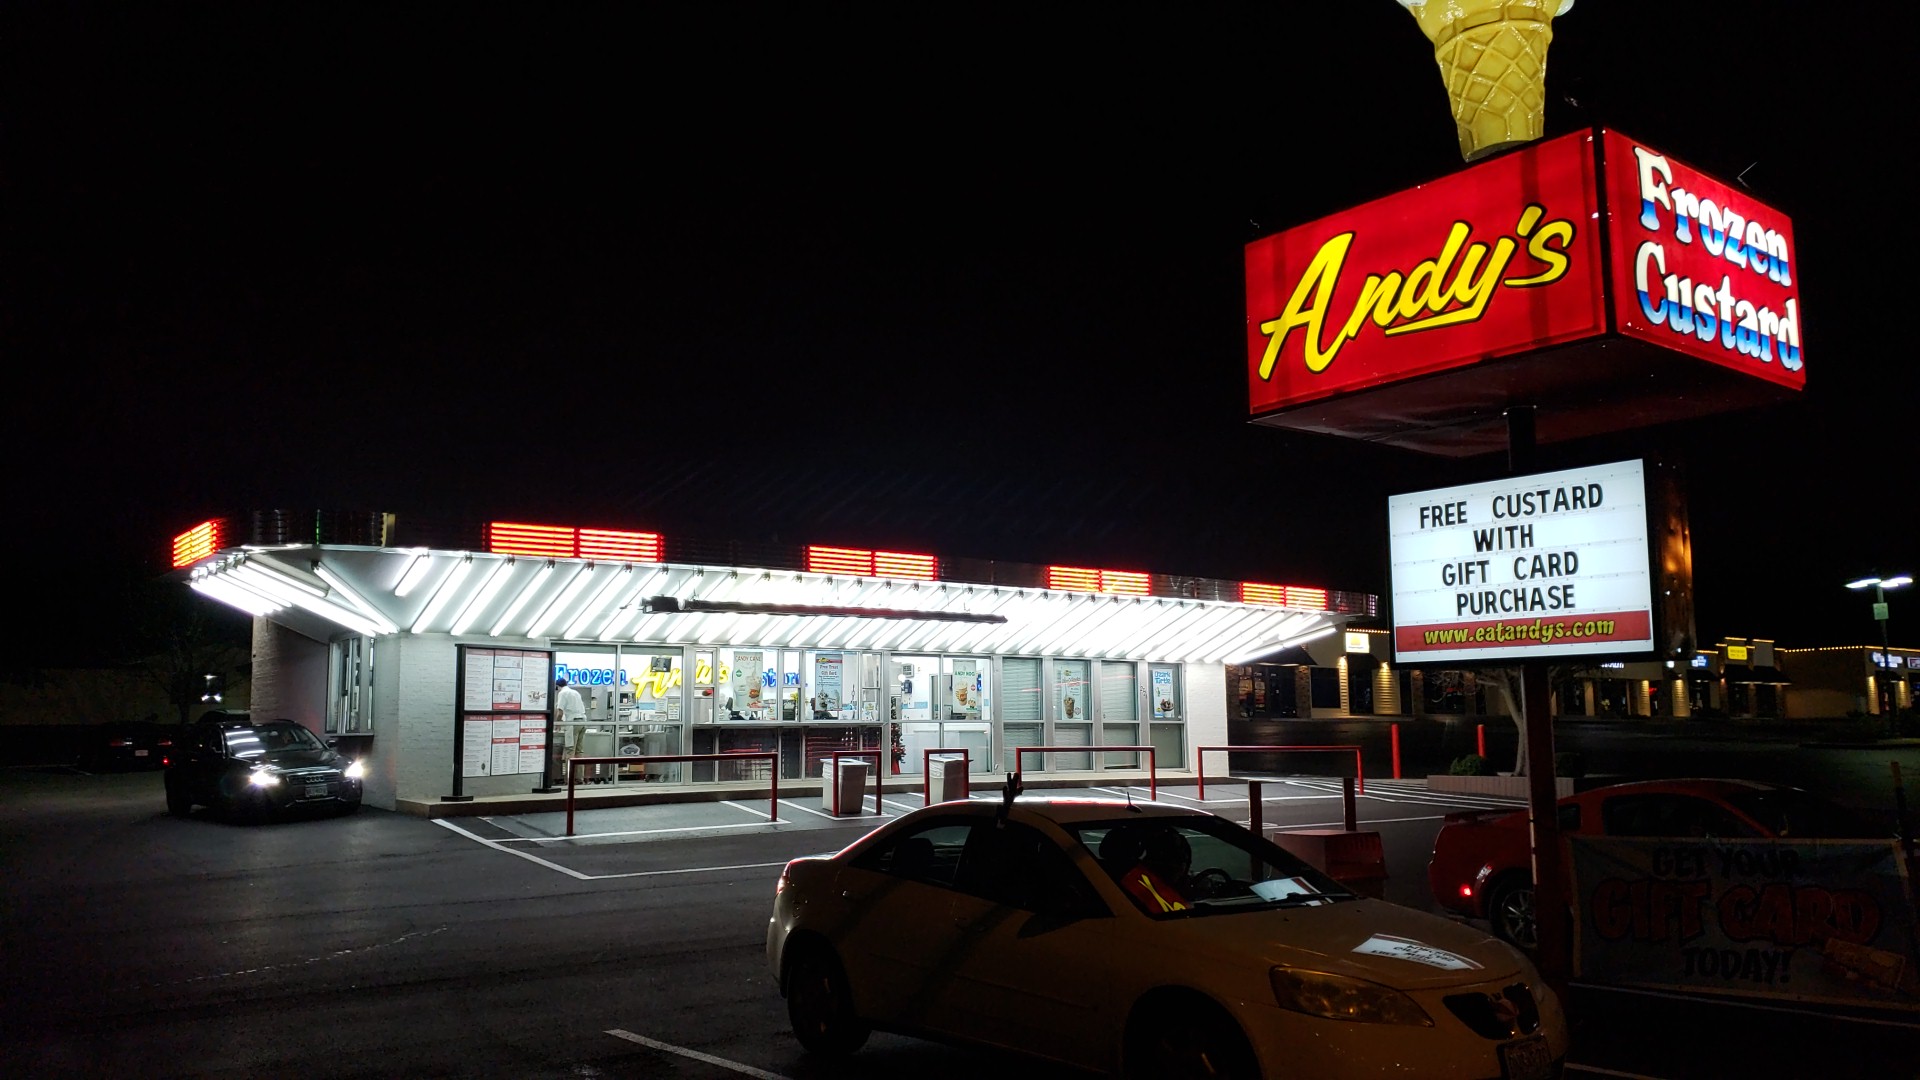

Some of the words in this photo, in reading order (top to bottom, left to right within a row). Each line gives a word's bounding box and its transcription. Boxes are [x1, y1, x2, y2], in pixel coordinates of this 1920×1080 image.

[1633, 145, 1792, 288] Frozen
[1259, 204, 1576, 382] Andy's
[1634, 240, 1804, 372] Custard
[1419, 501, 1468, 529] FREE
[1492, 483, 1603, 519] CUSTARD
[1473, 524, 1534, 552] WITH
[1442, 560, 1490, 586] GIFT
[1514, 551, 1579, 580] CARD
[1456, 584, 1576, 616] PURCHASE
[1424, 618, 1615, 644] www.eatandys.com
[1652, 846, 1703, 877] GET
[1590, 876, 1712, 943] GIFT
[1716, 881, 1884, 947] CARD
[1681, 947, 1793, 983] TODAY!
